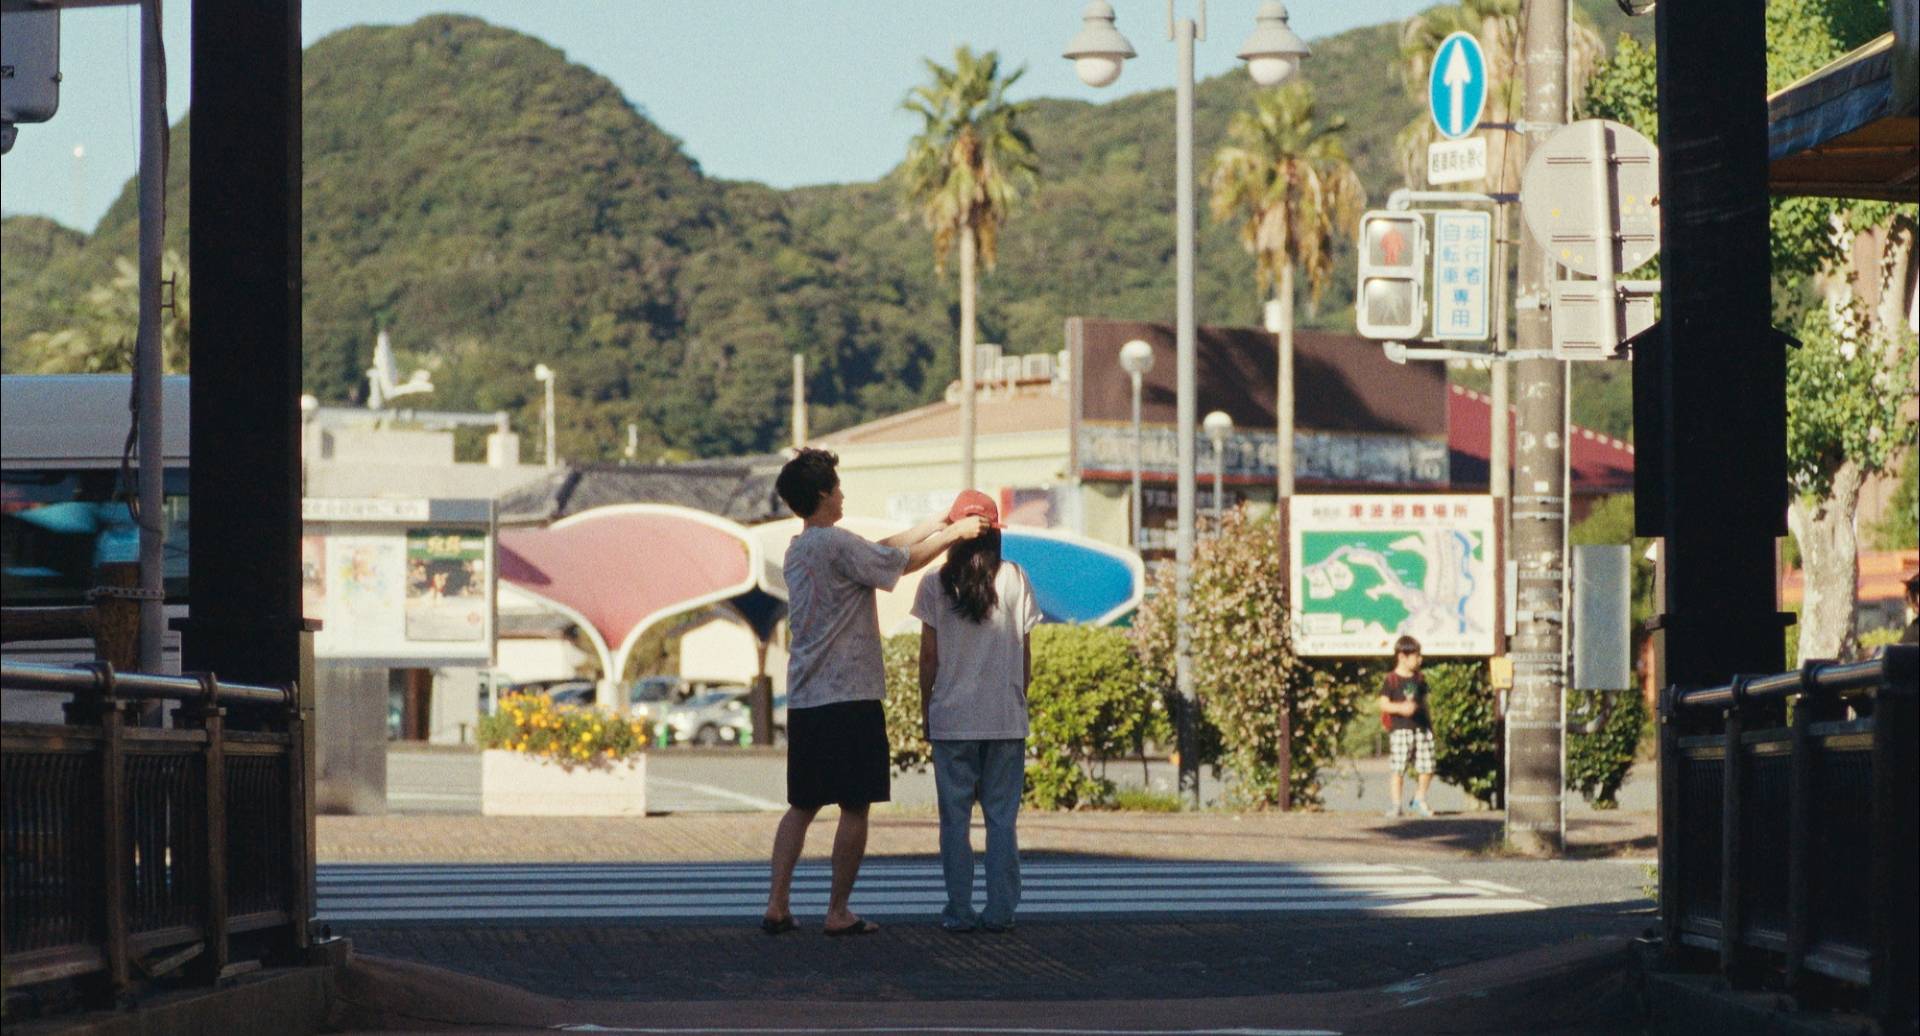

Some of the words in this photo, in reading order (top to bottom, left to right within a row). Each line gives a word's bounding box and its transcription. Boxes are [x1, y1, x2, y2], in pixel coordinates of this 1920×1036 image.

[1443, 224, 1460, 283] 自転車
[1465, 223, 1482, 285] 歩行者
[1350, 503, 1468, 518] 津波避難場所
